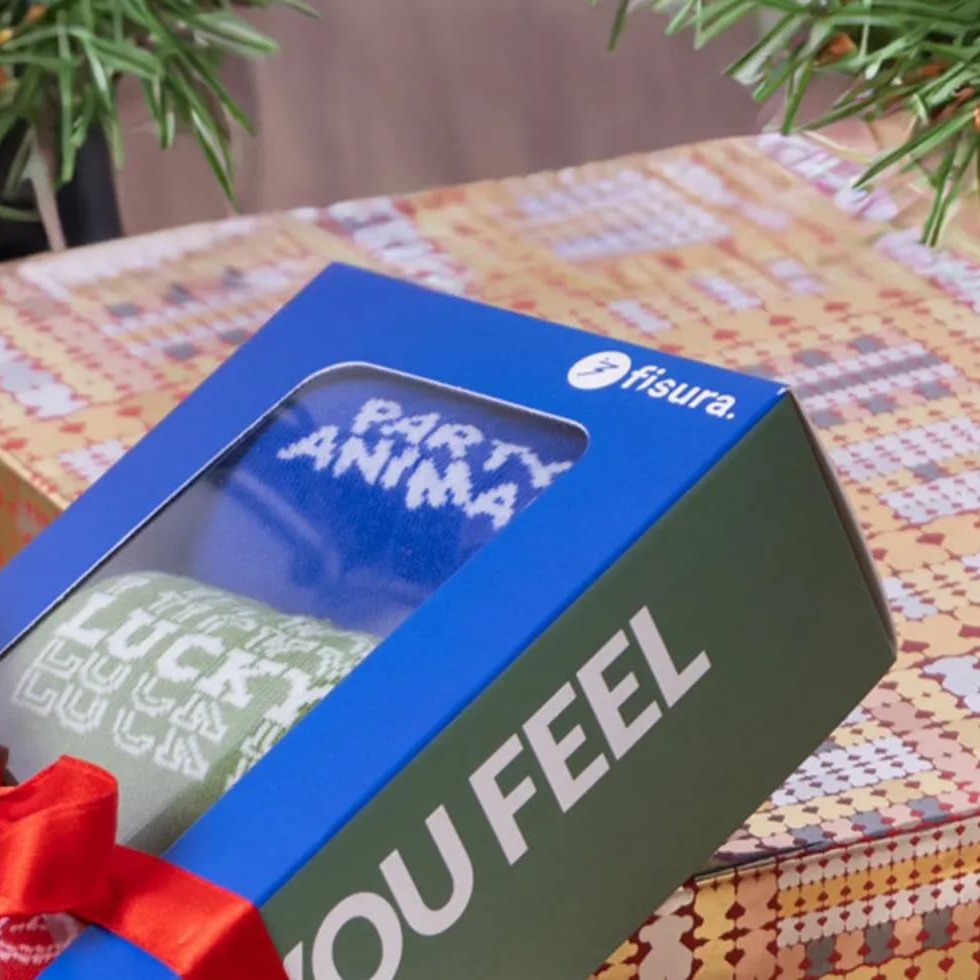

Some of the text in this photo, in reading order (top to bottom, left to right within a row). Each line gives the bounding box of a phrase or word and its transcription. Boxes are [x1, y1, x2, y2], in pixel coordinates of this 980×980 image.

[350, 397, 574, 488] PARTY
[620, 365, 736, 420] fisura.
[54, 593, 333, 727] LUCKY
[469, 606, 712, 865] FEEL
